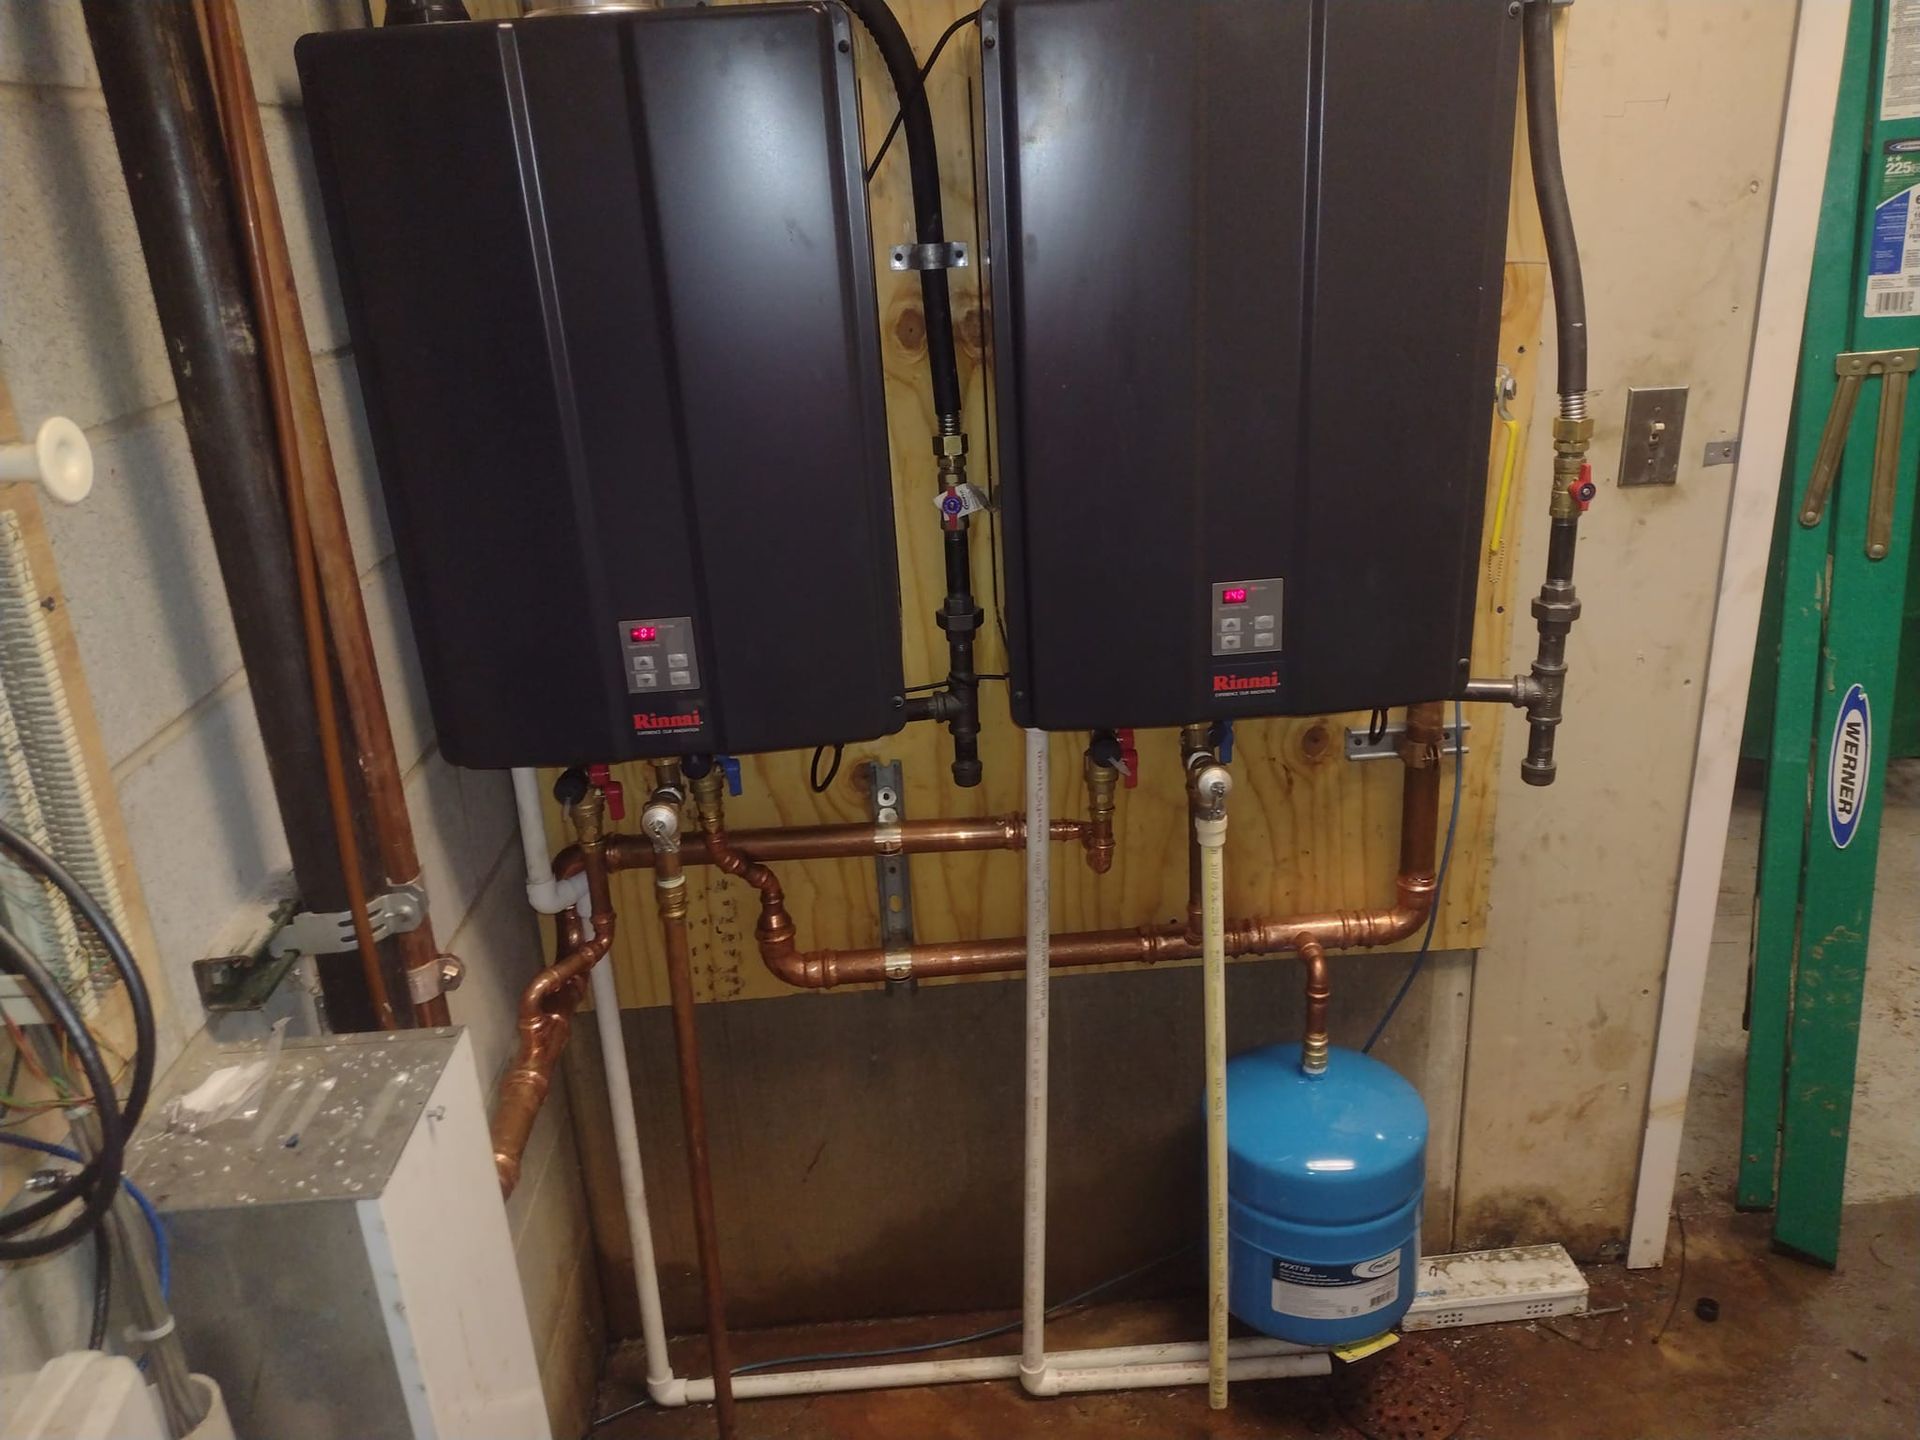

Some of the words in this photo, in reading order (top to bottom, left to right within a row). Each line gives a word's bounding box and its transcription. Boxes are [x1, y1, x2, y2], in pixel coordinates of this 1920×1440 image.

[1884, 160, 1912, 175] 225
[1213, 670, 1278, 690] Rinnai
[632, 709, 700, 729] Rinnai
[1838, 722, 1862, 816] WERNER
